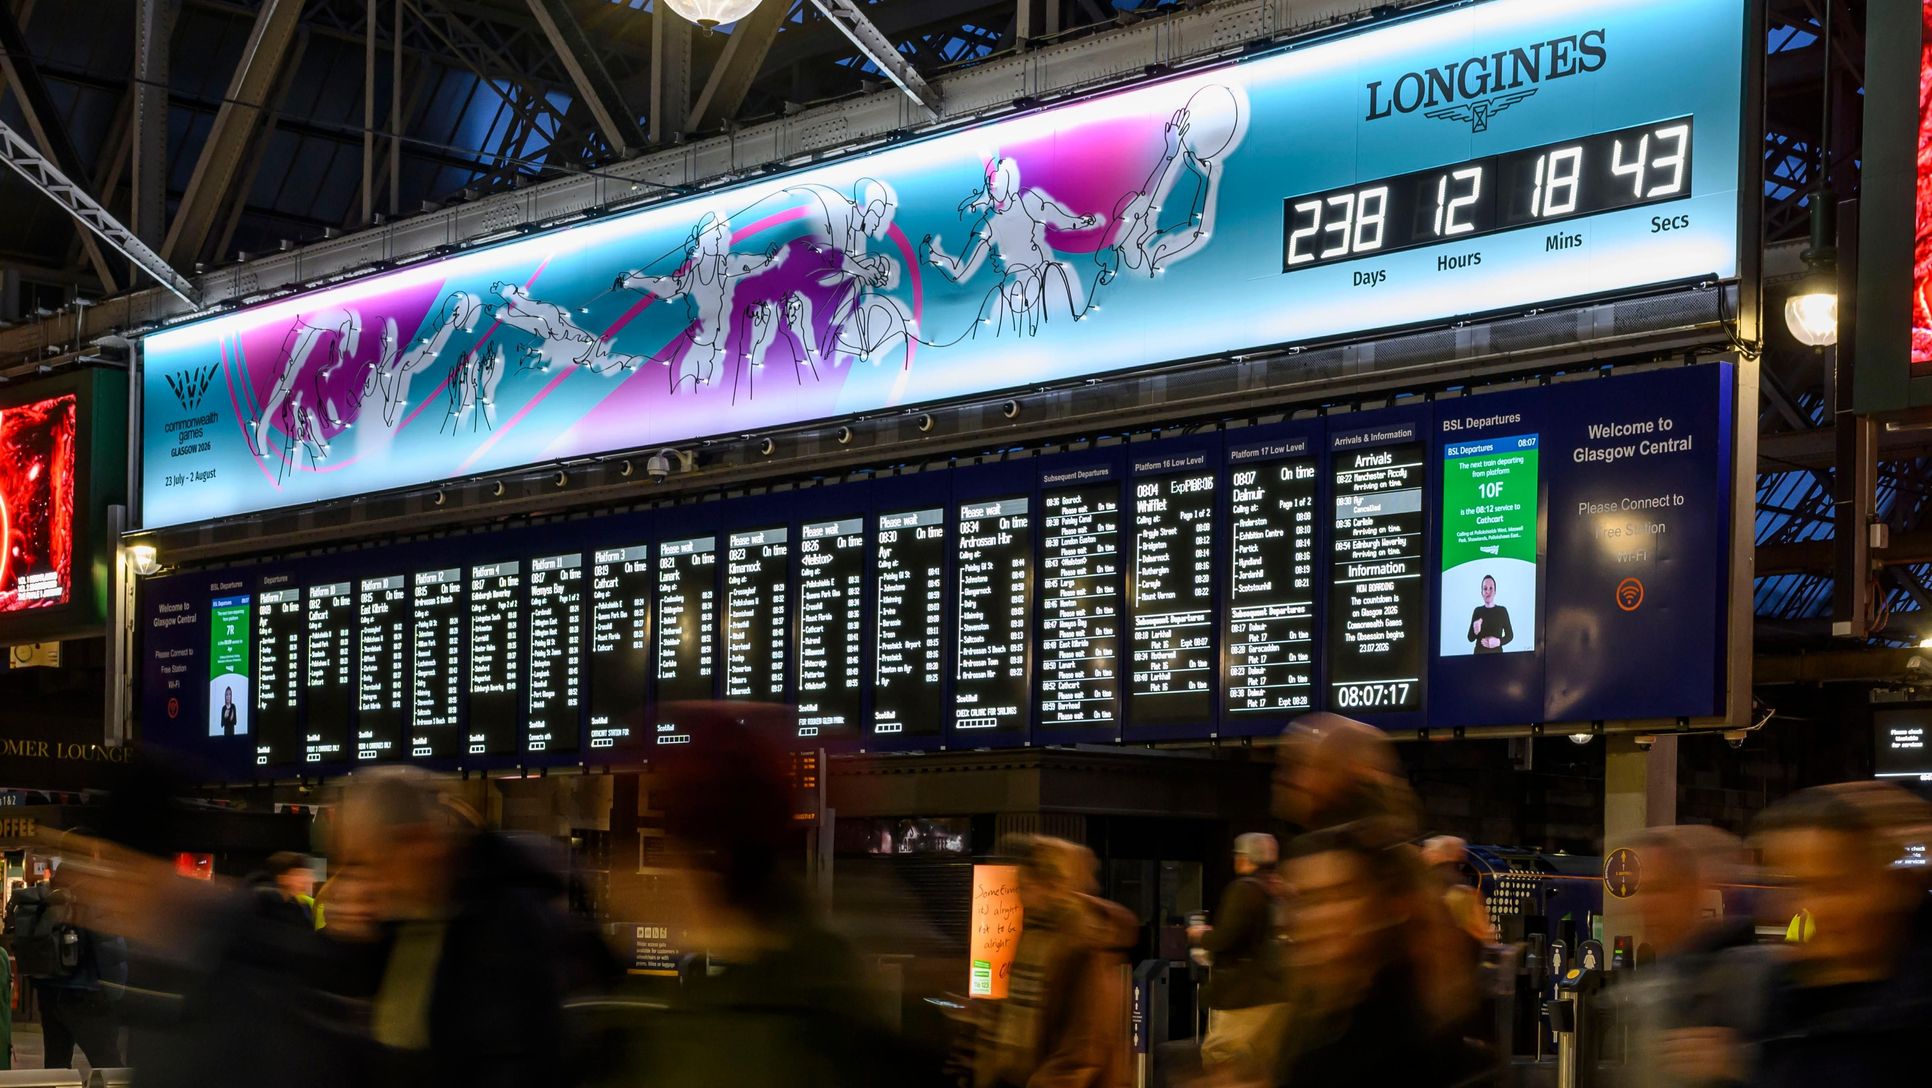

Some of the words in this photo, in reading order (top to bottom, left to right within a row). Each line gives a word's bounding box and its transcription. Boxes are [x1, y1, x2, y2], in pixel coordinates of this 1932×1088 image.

[1366, 29, 1606, 120] LONGINES
[1288, 187, 1388, 264] 238
[1434, 167, 1482, 235] 12
[1532, 146, 1582, 217] 18
[1612, 124, 1688, 198] 43
[1353, 268, 1386, 286] Days
[1438, 251, 1481, 271] Hours
[1546, 232, 1582, 251] Mins
[1652, 214, 1689, 232] Secs
[165, 411, 218, 433] commonwealth
[1444, 420, 1463, 431] BSL
[1466, 414, 1520, 429] Departures
[1589, 421, 1654, 439] Welcome
[1659, 417, 1673, 431] to
[179, 428, 203, 444] games
[1335, 435, 1361, 446] Arrivals
[1371, 429, 1411, 441] Information
[171, 445, 197, 457] GLASGOW
[198, 442, 211, 452] 2026
[1232, 450, 1259, 459] Platform
[1286, 442, 1304, 452] Level
[1448, 447, 1459, 455] BSL
[1461, 444, 1493, 455] Departures
[1518, 438, 1536, 447] 08:07
[1574, 445, 1635, 462] Glasgow
[1640, 435, 1692, 455] Central
[1135, 462, 1161, 471] Platform
[1187, 456, 1204, 464] Level
[1355, 452, 1392, 468] Arrivals
[1497, 457, 1524, 466] departing
[165, 476, 172, 486] 23
[173, 474, 185, 486] July
[190, 472, 194, 481] 2
[195, 469, 216, 482] August
[1044, 472, 1076, 482] Subsequent
[1078, 469, 1108, 478] Departures
[1234, 472, 1256, 486] 08:07
[1281, 468, 1292, 480] On
[1296, 466, 1314, 478] time
[1486, 468, 1510, 477] platform
[1137, 483, 1158, 497] 08:04
[1233, 487, 1265, 502] Dalmuir
[1479, 482, 1504, 498] 10F
[962, 507, 983, 518] Please
[986, 503, 1001, 515] wait
[1137, 499, 1167, 513] Whifflet
[1233, 505, 1249, 514] Calling
[1280, 500, 1292, 510] Page
[1299, 498, 1306, 506] of
[1476, 505, 1493, 513] 08:12
[1579, 502, 1617, 515] Please
[1622, 494, 1669, 510] Connect
[1673, 494, 1684, 505] to
[880, 517, 901, 528] Please
[904, 514, 918, 526] wait
[960, 521, 979, 534] 08:34
[1000, 518, 1010, 529] On
[1012, 516, 1027, 528] time
[1477, 516, 1504, 524] Cathcart
[803, 527, 823, 538] Please
[825, 523, 838, 535] wait
[879, 531, 897, 543] 08:30
[916, 528, 926, 539] On
[928, 526, 943, 538] time
[730, 535, 750, 546] Please
[751, 533, 764, 544] wait
[802, 540, 819, 552] 08:26
[837, 537, 846, 548] On
[848, 536, 862, 547] time
[960, 536, 996, 548] Ardrossan
[998, 532, 1012, 544] Hbr
[661, 544, 679, 555] Please
[681, 541, 693, 552] wait
[729, 549, 746, 560] 08:23
[763, 546, 771, 557] On
[773, 545, 787, 556] time
[879, 546, 892, 559] Ayr
[532, 560, 555, 571] Platform
[557, 557, 562, 568] 11
[596, 551, 619, 563] Platform
[621, 550, 625, 560] 3
[660, 557, 675, 569] 08:21
[692, 555, 700, 565] On
[702, 553, 714, 564] time
[594, 565, 609, 576] 08:19
[625, 562, 632, 573] On
[634, 561, 646, 572] time
[729, 560, 761, 574] Kilmarnock
[1348, 562, 1405, 578] Information
[264, 576, 288, 584] Departures
[594, 577, 618, 589] Cathcart
[660, 570, 680, 582] Lanark
[211, 583, 219, 591] BSL
[220, 581, 242, 590] Departures
[531, 586, 552, 596] Wemyss
[554, 583, 564, 594] Bay
[1363, 595, 1392, 604] countdown
[159, 604, 182, 613] Welcome
[309, 610, 328, 621] Cathcart
[1361, 608, 1382, 618] Glasgow
[1384, 606, 1398, 615] 2026
[154, 617, 176, 628] Glasgow
[177, 613, 196, 624] Central
[1347, 620, 1383, 630] Commonwealth
[1385, 618, 1402, 627] Games
[226, 625, 234, 635] 7R
[1345, 633, 1355, 641] The
[1386, 630, 1404, 640] begins
[171, 649, 188, 658] Connect
[1360, 643, 1389, 653] 23.07.2026
[161, 665, 172, 673] Free
[1338, 684, 1409, 706] 08:07:17
[984, 938, 1010, 952] alright
